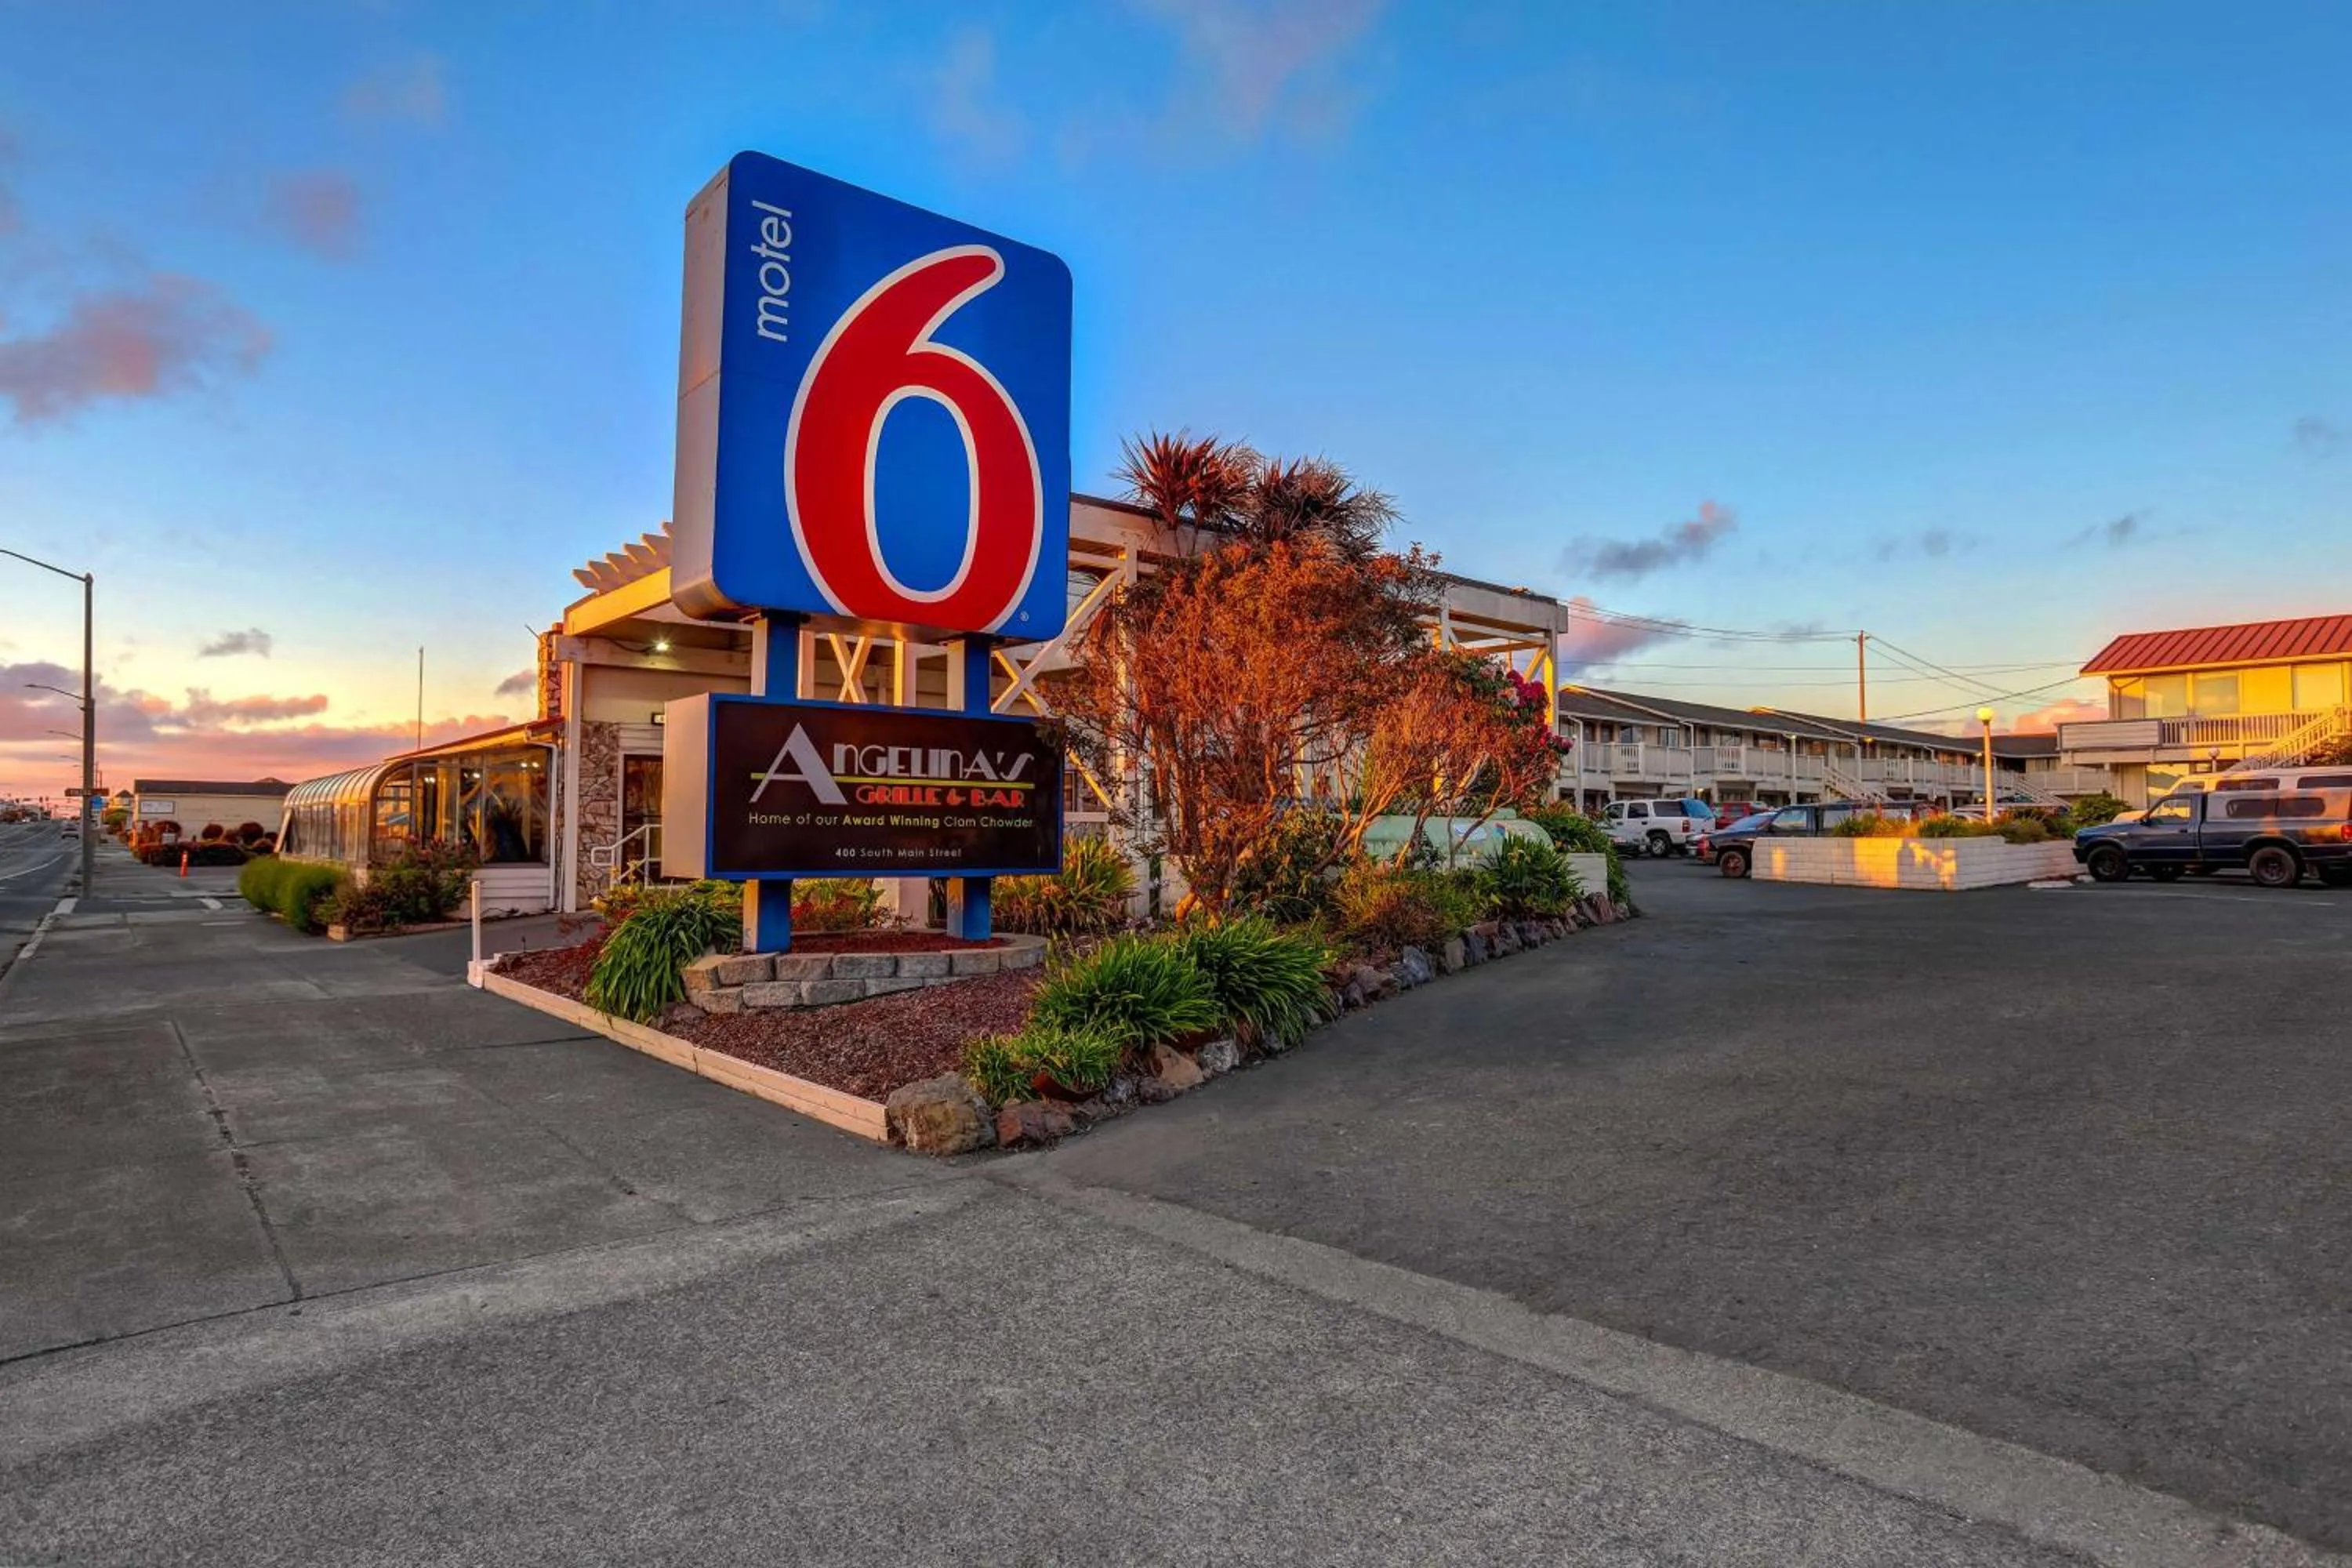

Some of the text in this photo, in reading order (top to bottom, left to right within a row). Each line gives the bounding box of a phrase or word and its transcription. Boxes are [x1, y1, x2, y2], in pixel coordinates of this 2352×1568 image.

[751, 200, 792, 342] motel
[784, 244, 1043, 633] 6
[749, 722, 1035, 806] ANGELINA'S
[749, 811, 1033, 829] Home of our Award Winning Clam Chowder
[856, 786, 1025, 808] GRILLE & BAR
[835, 848, 962, 858] 400 South Main Street
